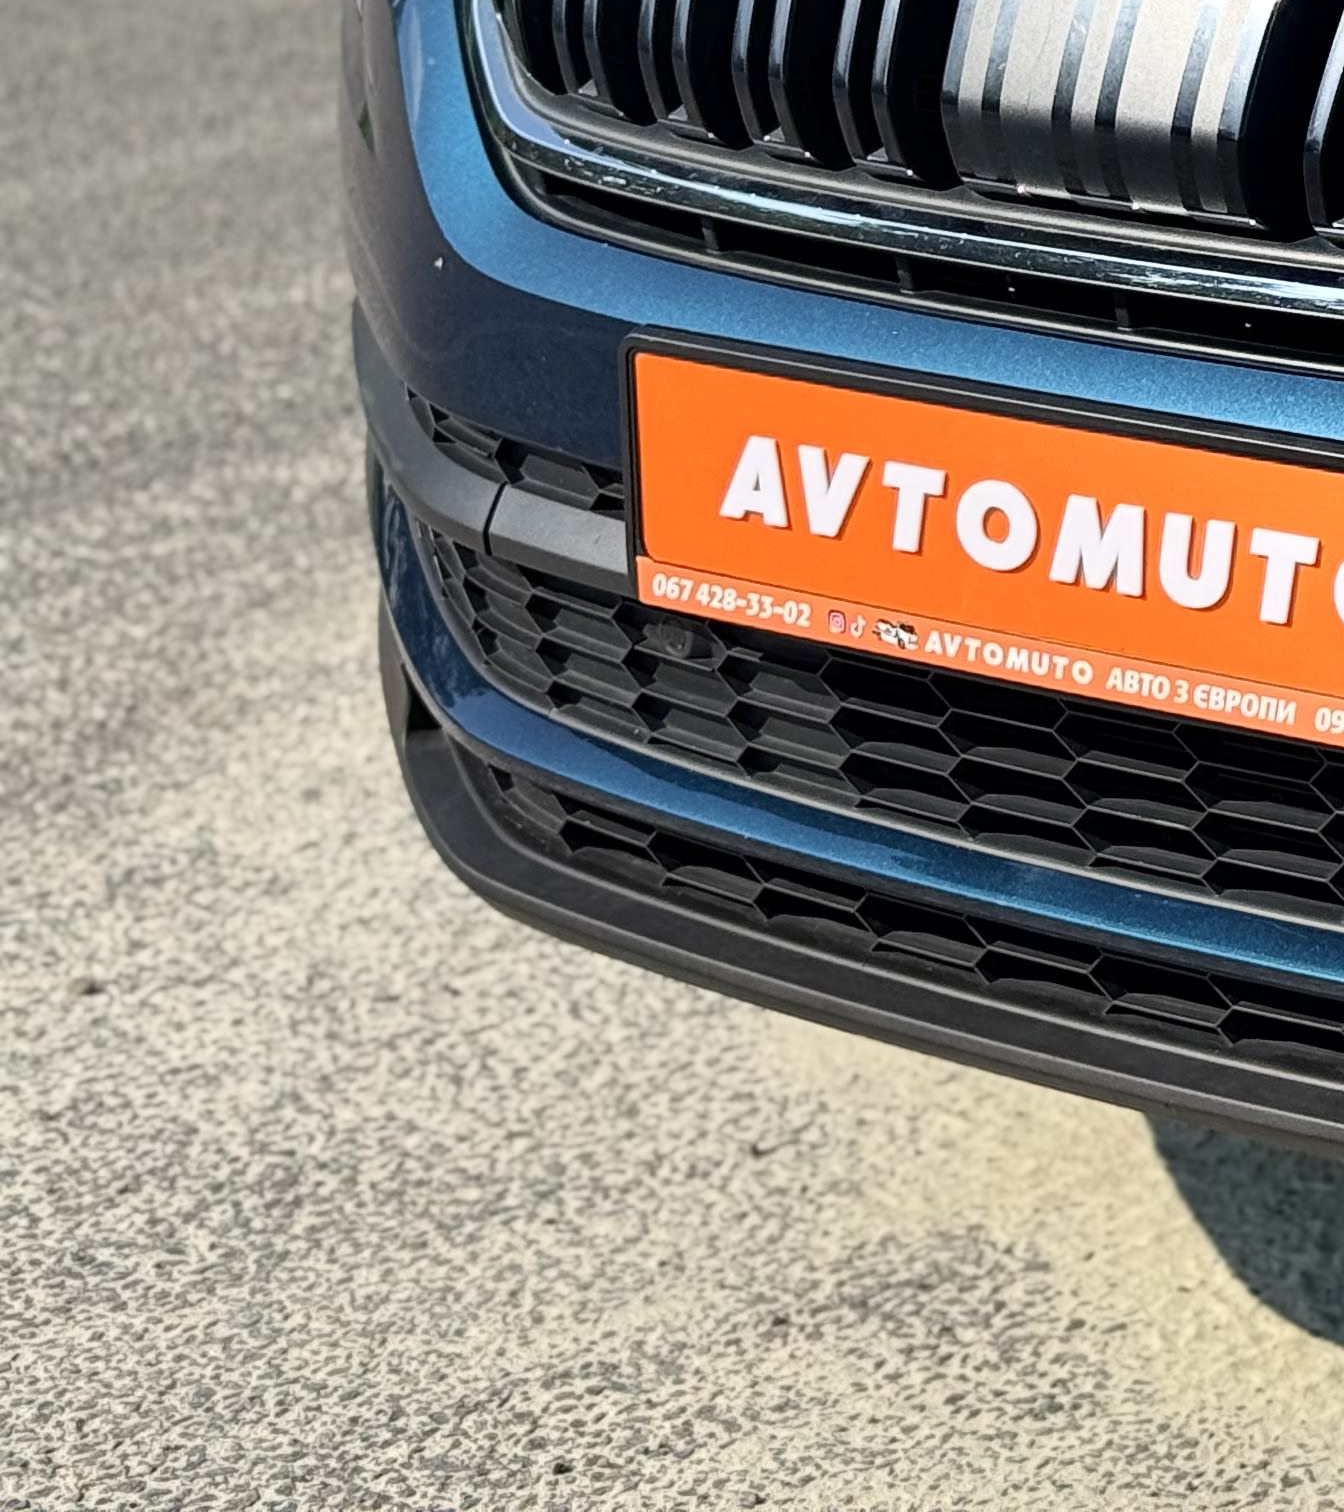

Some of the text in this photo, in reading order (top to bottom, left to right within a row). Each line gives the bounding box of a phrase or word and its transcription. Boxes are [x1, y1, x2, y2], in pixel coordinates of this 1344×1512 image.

[652, 572, 811, 628] 067 428-33-02
[924, 630, 1094, 685] AVTOMUTO
[1105, 666, 1171, 701] АВТО
[1193, 683, 1297, 727] ЄВРОПИ
